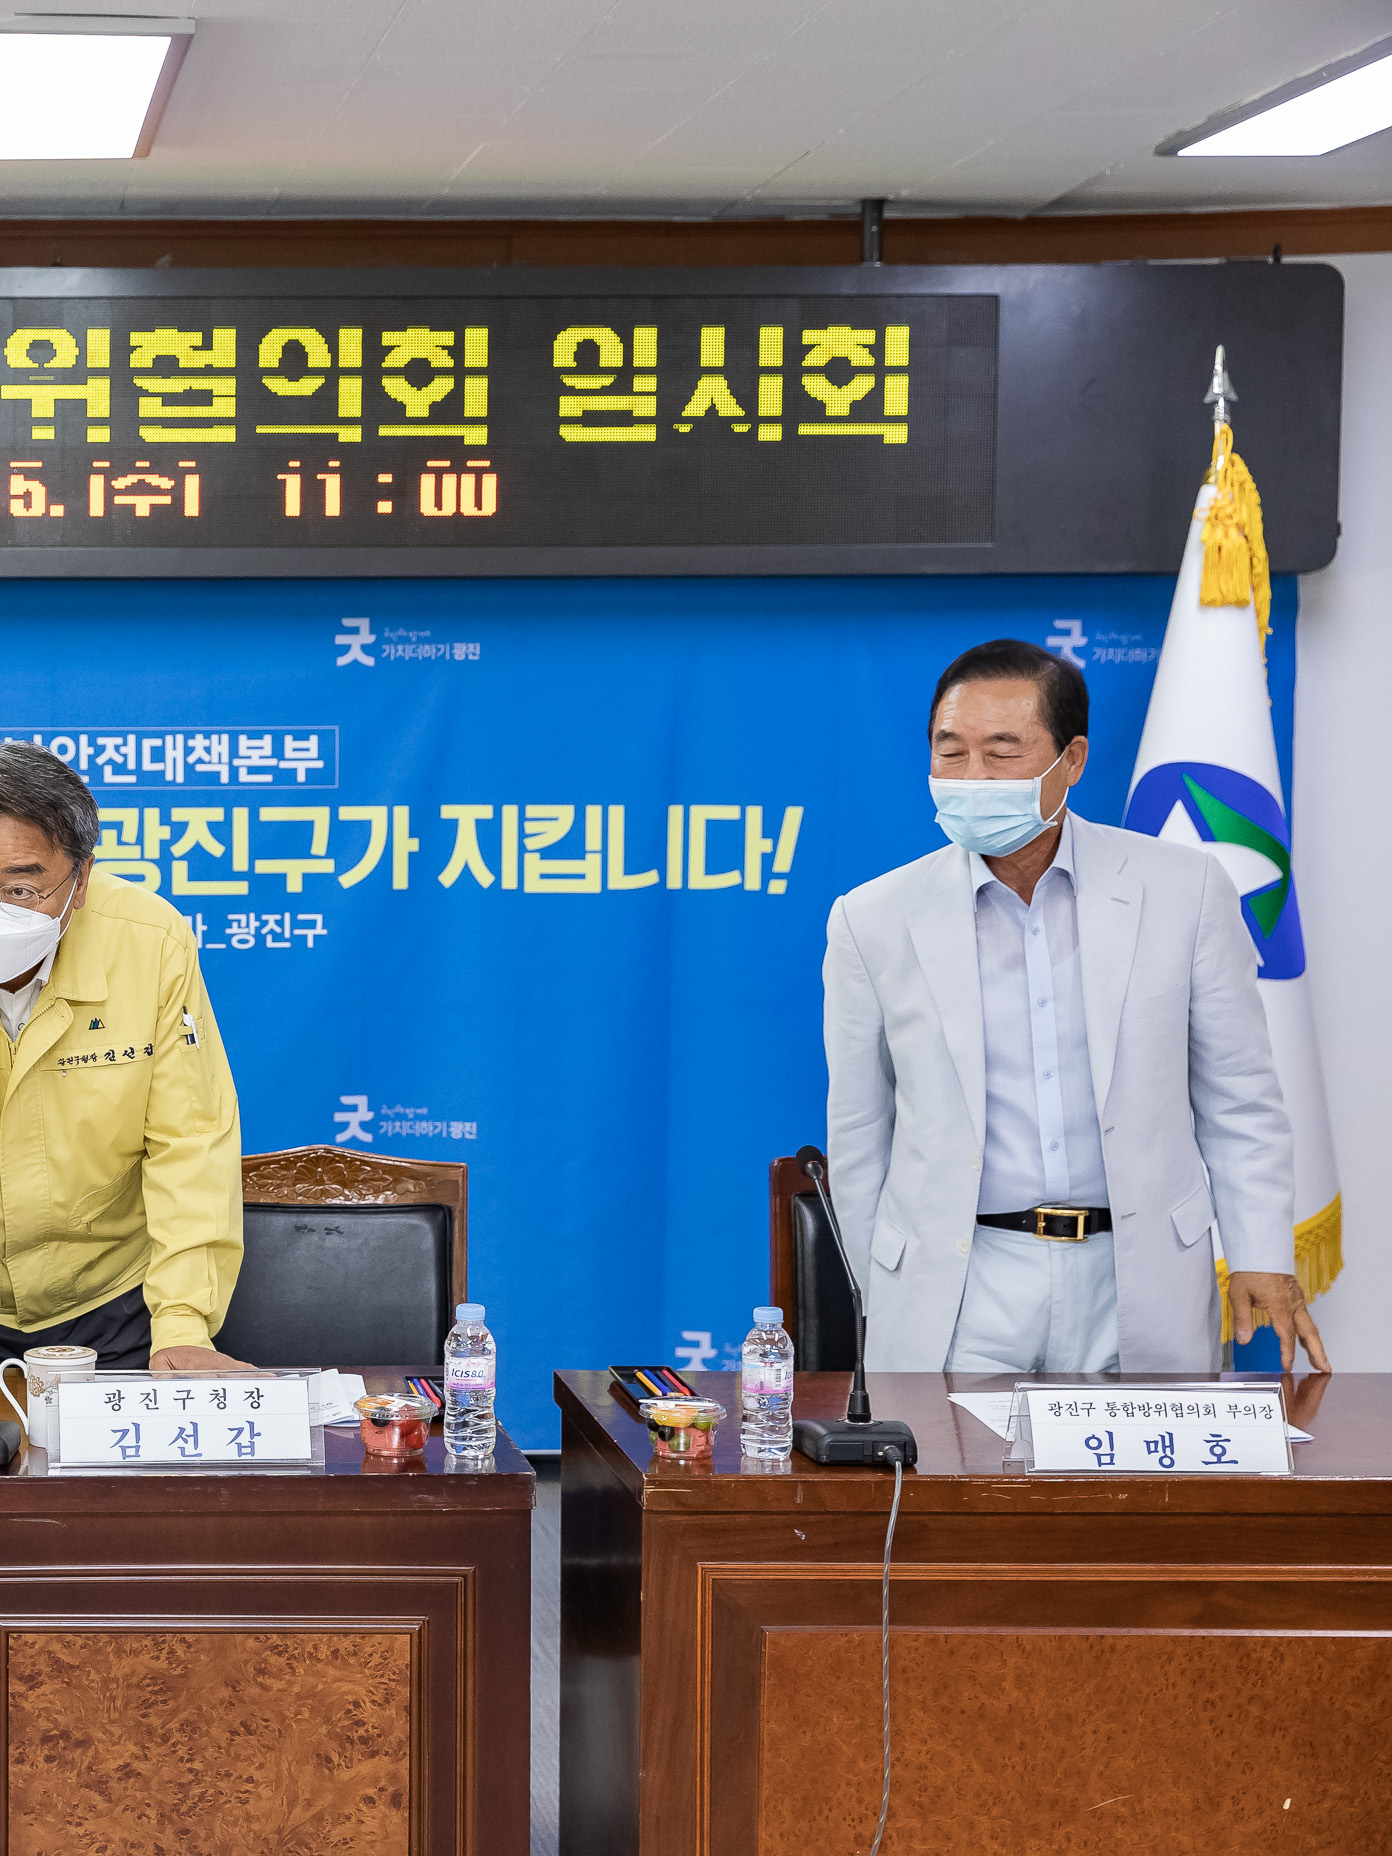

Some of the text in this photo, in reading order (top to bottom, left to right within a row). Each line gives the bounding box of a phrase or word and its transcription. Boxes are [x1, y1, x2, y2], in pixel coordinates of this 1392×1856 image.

[552, 323, 910, 444] 임시회
[276, 460, 341, 518] 11
[419, 459, 498, 517] 00
[381, 642, 481, 661] 가치더하기 광진
[92, 805, 419, 895] 광진구가
[438, 804, 804, 894] 지킵니다!
[380, 1121, 477, 1139] 가치더하기 광진
[1048, 1401, 1275, 1420] 광진구 통합방위협의회 부의장
